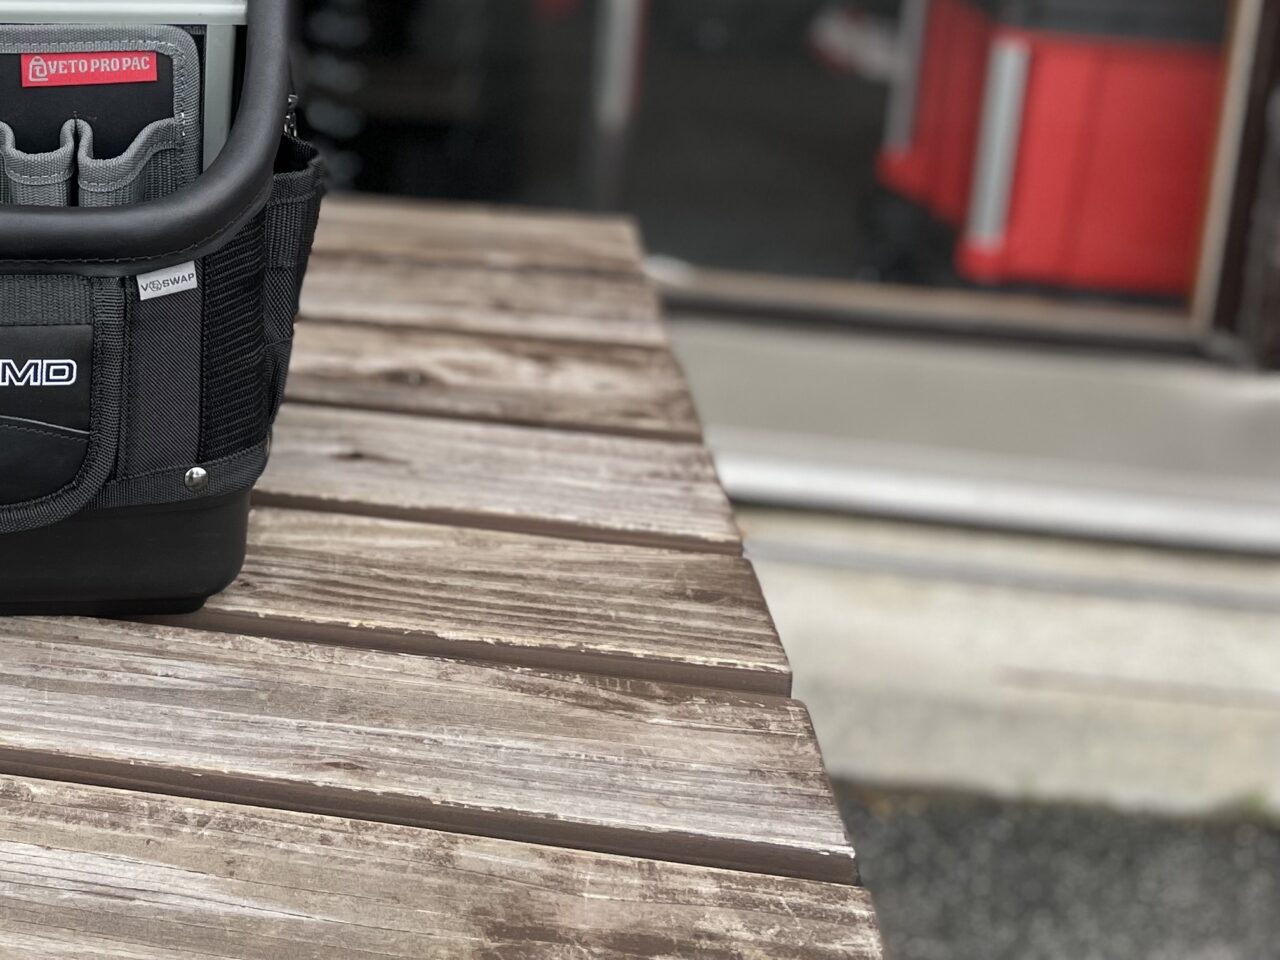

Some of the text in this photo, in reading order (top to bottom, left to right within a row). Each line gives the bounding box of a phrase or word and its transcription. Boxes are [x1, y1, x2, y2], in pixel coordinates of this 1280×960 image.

[47, 56, 150, 74] VETO PRO PAC
